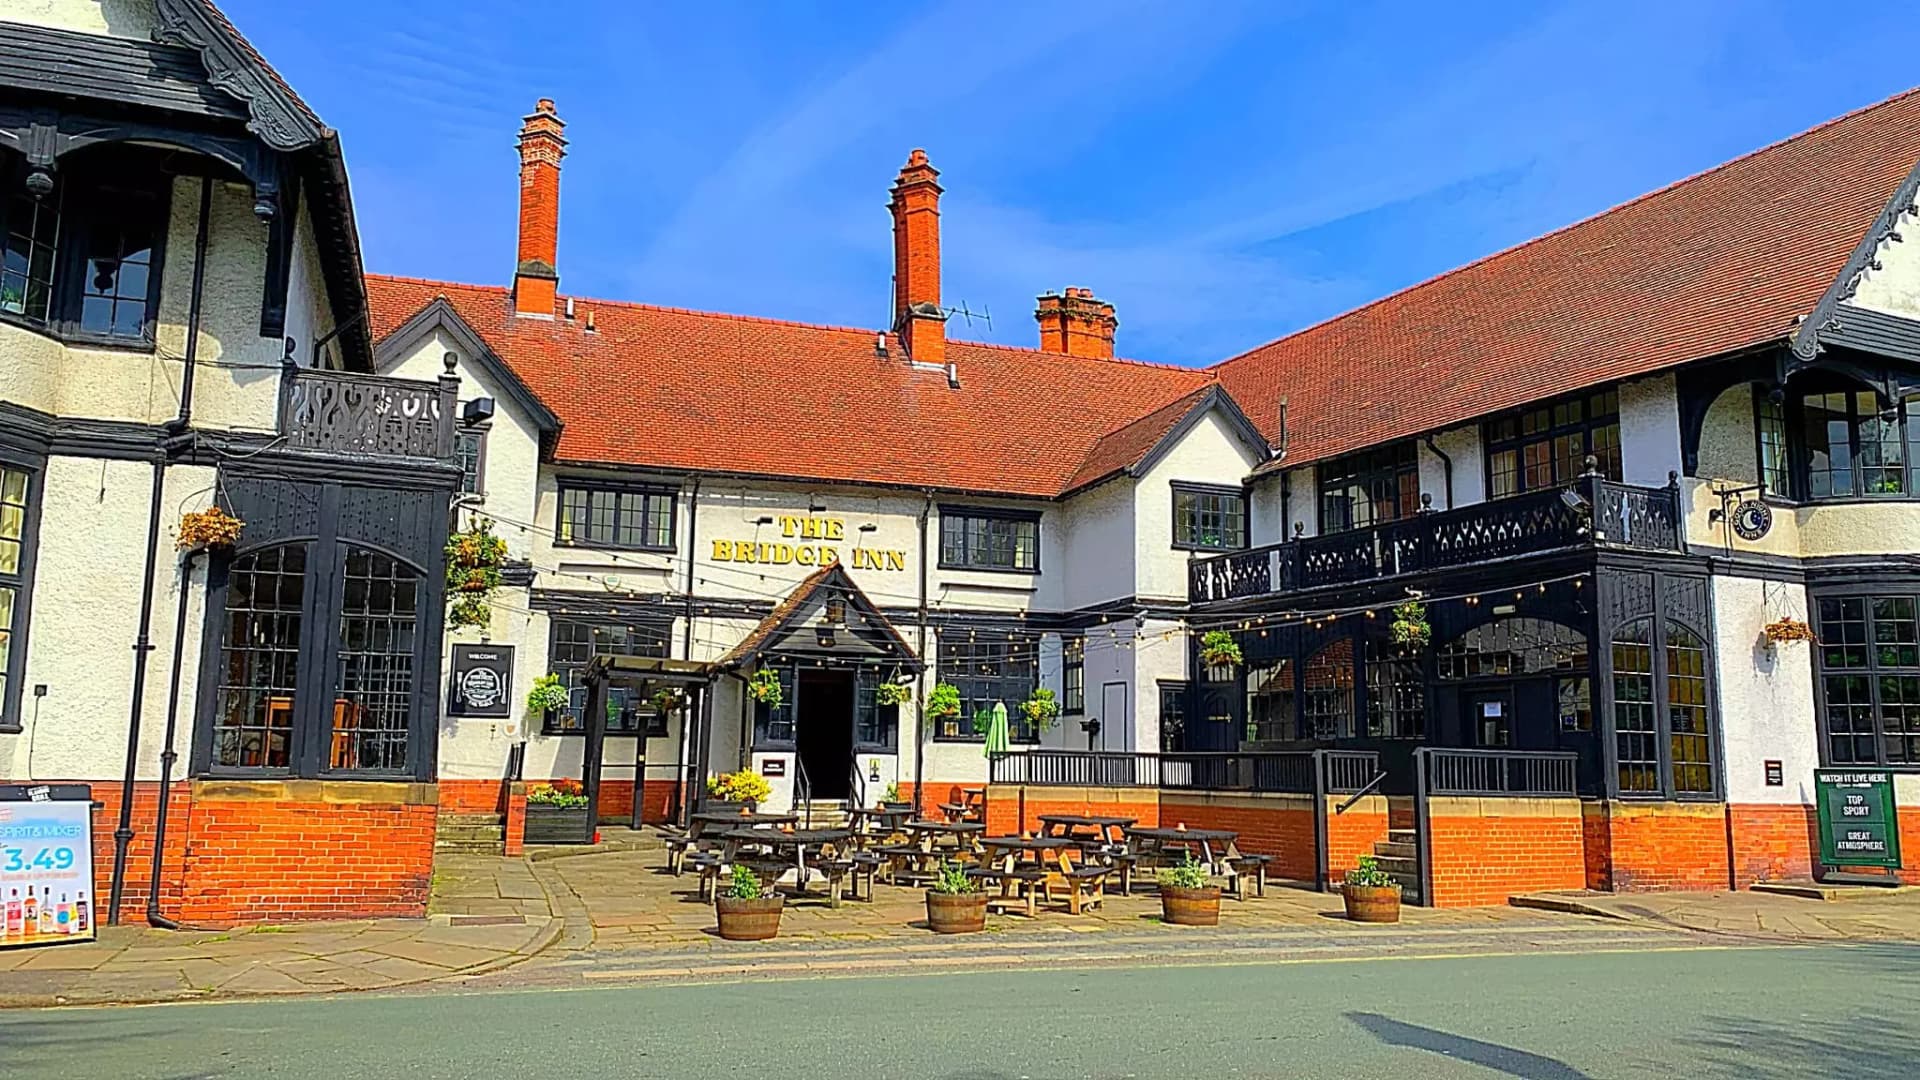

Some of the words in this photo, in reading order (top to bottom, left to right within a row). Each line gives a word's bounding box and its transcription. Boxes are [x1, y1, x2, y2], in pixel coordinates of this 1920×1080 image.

[1734, 504, 1748, 526] GOOD
[1751, 502, 1769, 520] NIGHT
[779, 516, 845, 540] THE
[711, 539, 838, 567] BRIDGE
[852, 547, 907, 571] INN
[1819, 774, 1843, 783] WATCH
[1844, 774, 1852, 783] IT
[1852, 774, 1869, 782] LIVE
[1868, 773, 1888, 782] HERE
[1846, 795, 1863, 805] TOP
[1843, 806, 1870, 816] SPORT
[1847, 832, 1871, 841] GREAT
[1837, 841, 1885, 850] ATMOSPHERE
[5, 847, 74, 871] 3.49
